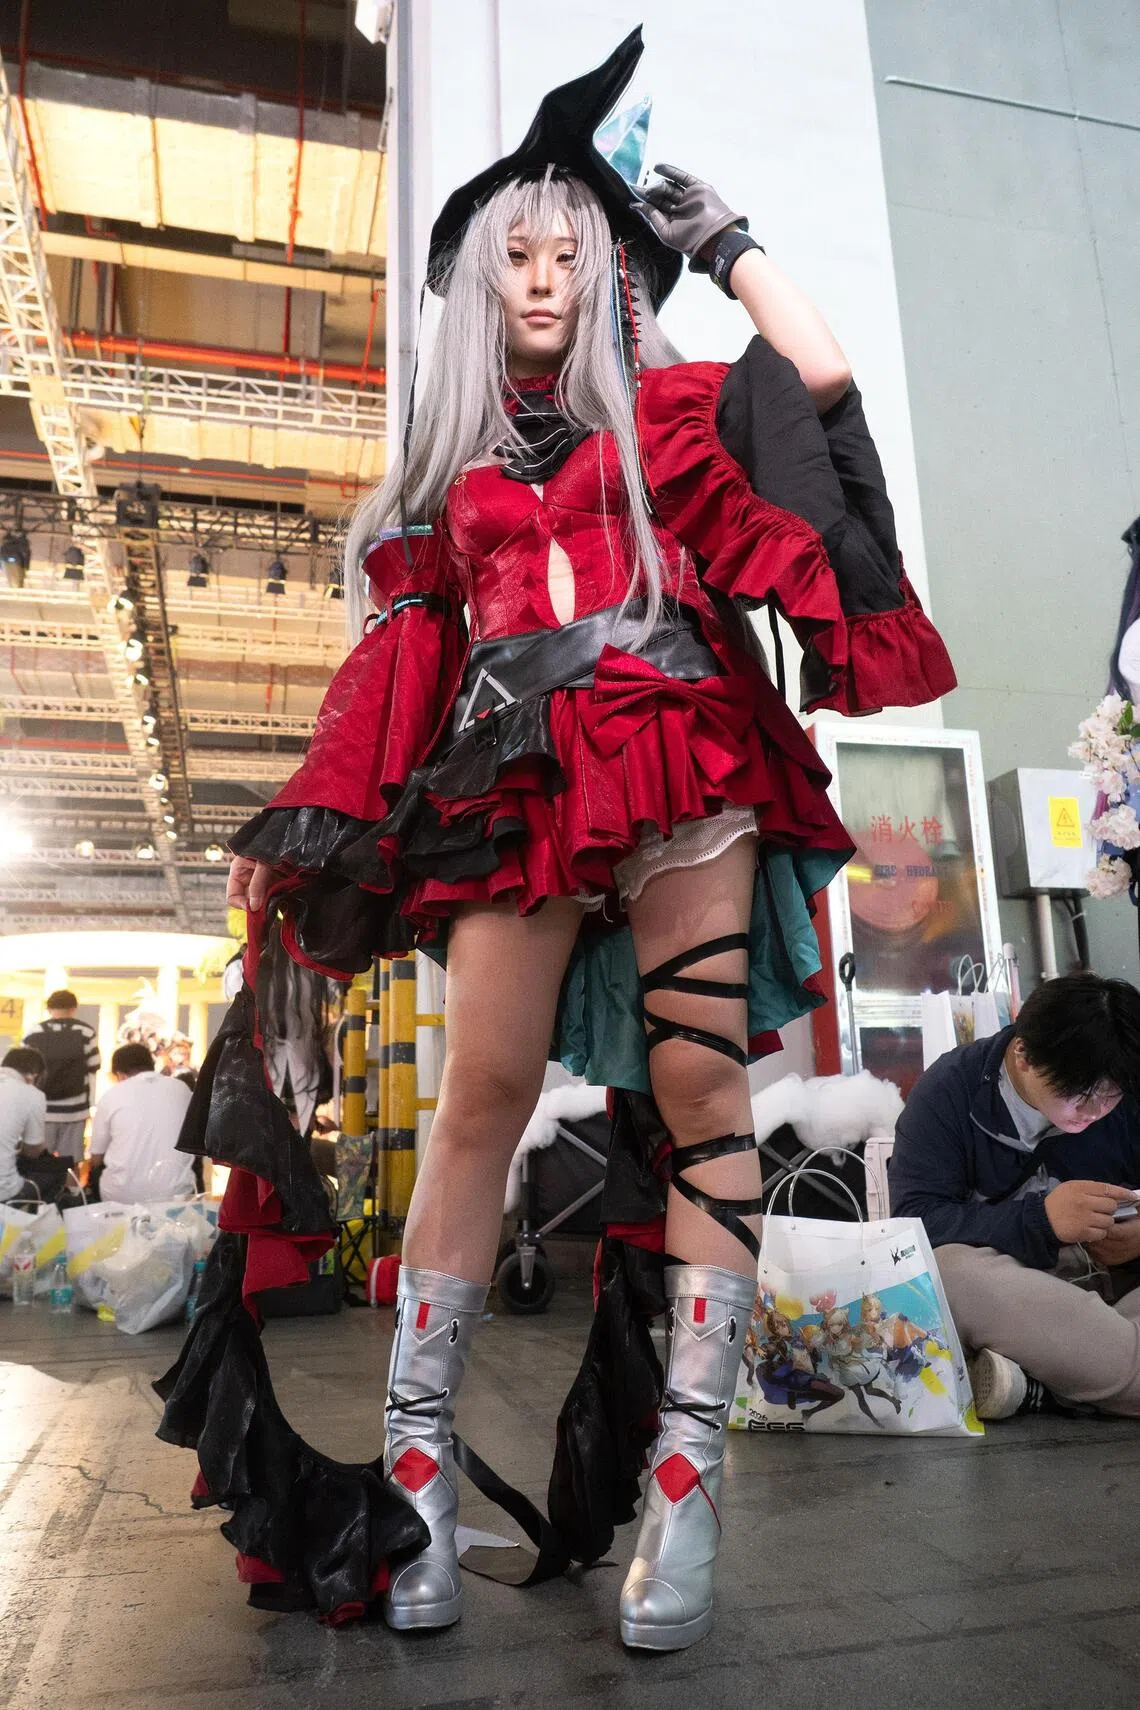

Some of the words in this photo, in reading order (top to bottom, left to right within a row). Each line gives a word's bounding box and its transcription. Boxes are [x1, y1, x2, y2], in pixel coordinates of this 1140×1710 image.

[871, 815, 943, 843] 消火栓
[749, 1408, 768, 1421] 2026
